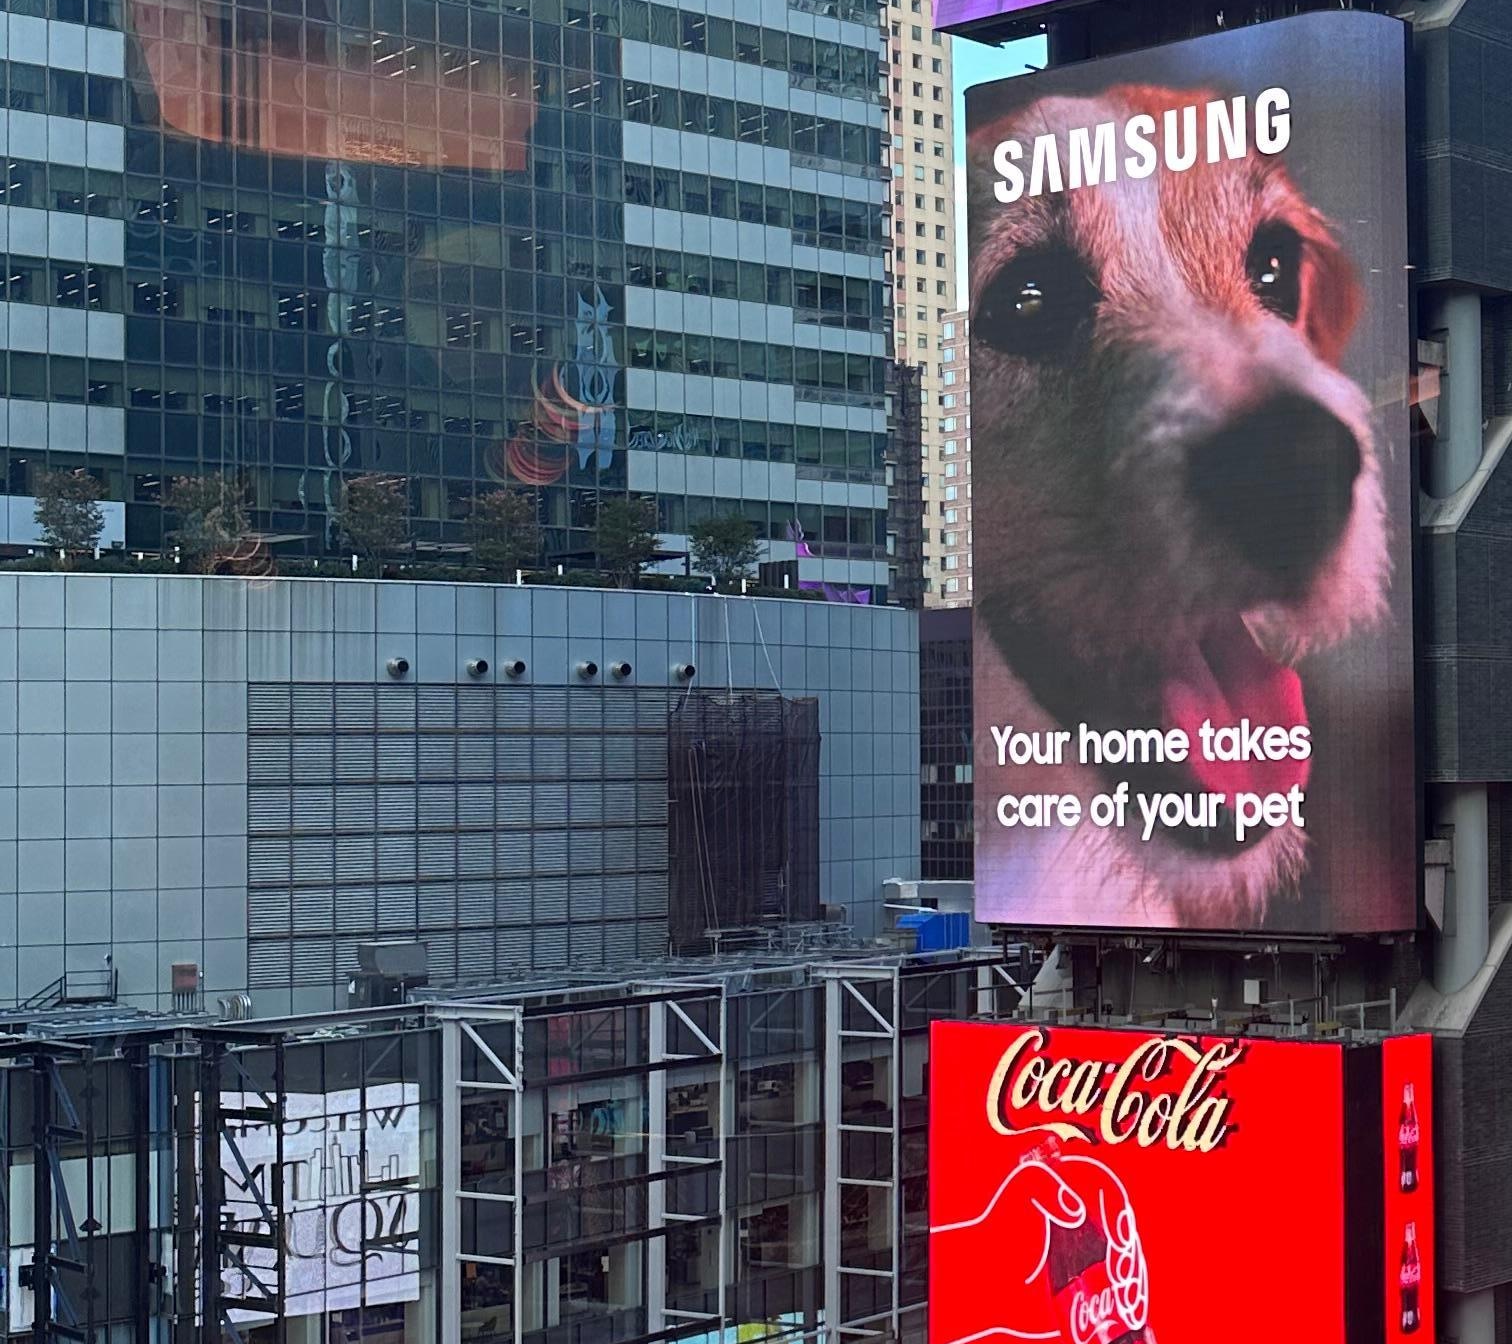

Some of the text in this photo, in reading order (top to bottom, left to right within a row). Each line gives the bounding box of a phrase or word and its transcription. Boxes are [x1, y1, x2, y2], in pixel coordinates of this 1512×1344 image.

[993, 87, 1292, 204] SAMSUNG
[990, 718, 1313, 766] Your home takes
[996, 781, 1306, 842] care of your pet
[986, 1028, 1247, 1153] Coca-Cola
